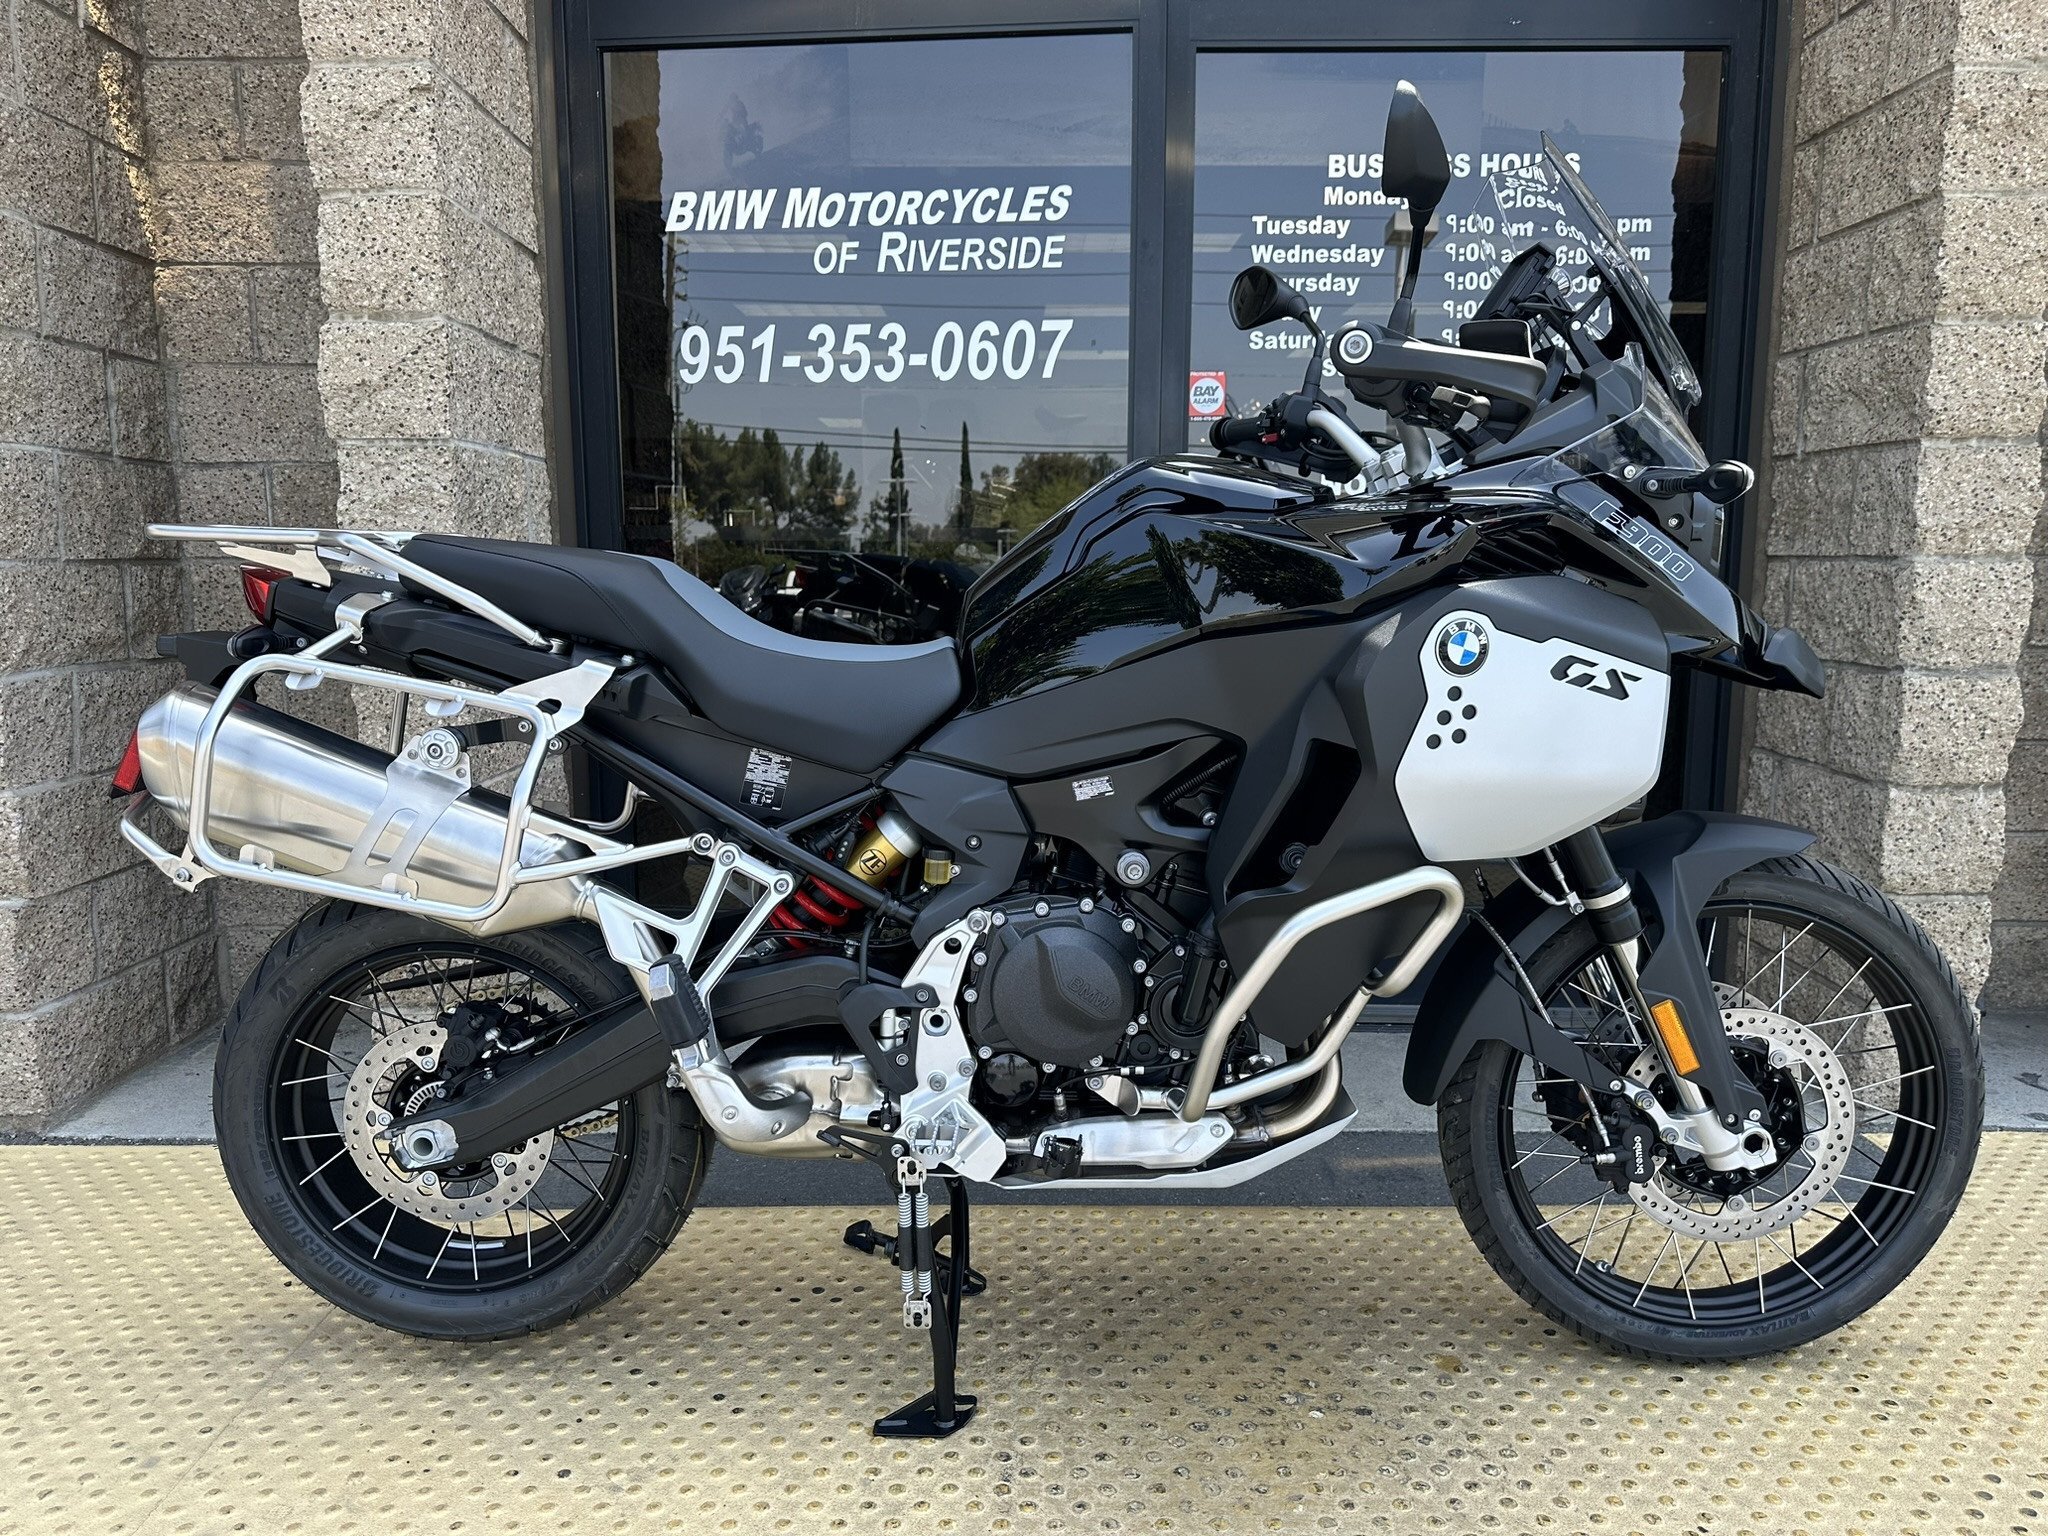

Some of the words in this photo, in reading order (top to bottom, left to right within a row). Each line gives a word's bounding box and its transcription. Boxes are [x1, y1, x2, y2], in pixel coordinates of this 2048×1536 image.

[1480, 152, 1581, 178] HOUS
[664, 188, 778, 232] BMW
[781, 184, 1074, 229] MOTORCYCLES
[1251, 215, 1351, 239] Tuesday
[1445, 214, 1495, 234] 9:00
[1616, 217, 1653, 238] pm
[813, 240, 860, 275] OF
[876, 231, 1067, 273] RIVERSIDE
[1250, 244, 1386, 268] Wednesday
[1284, 273, 1361, 296] ursday
[679, 318, 1074, 385] 951-353-0607
[1192, 397, 1219, 405] ALARM
[1193, 385, 1220, 397] BAY
[1589, 500, 1695, 582] F900
[1550, 655, 1643, 701] GS
[860, 849, 887, 875] ZF
[1067, 975, 1115, 1012] BMW
[1632, 1135, 1644, 1175] brembo
[263, 1191, 385, 1298] BRIDGESTONE
